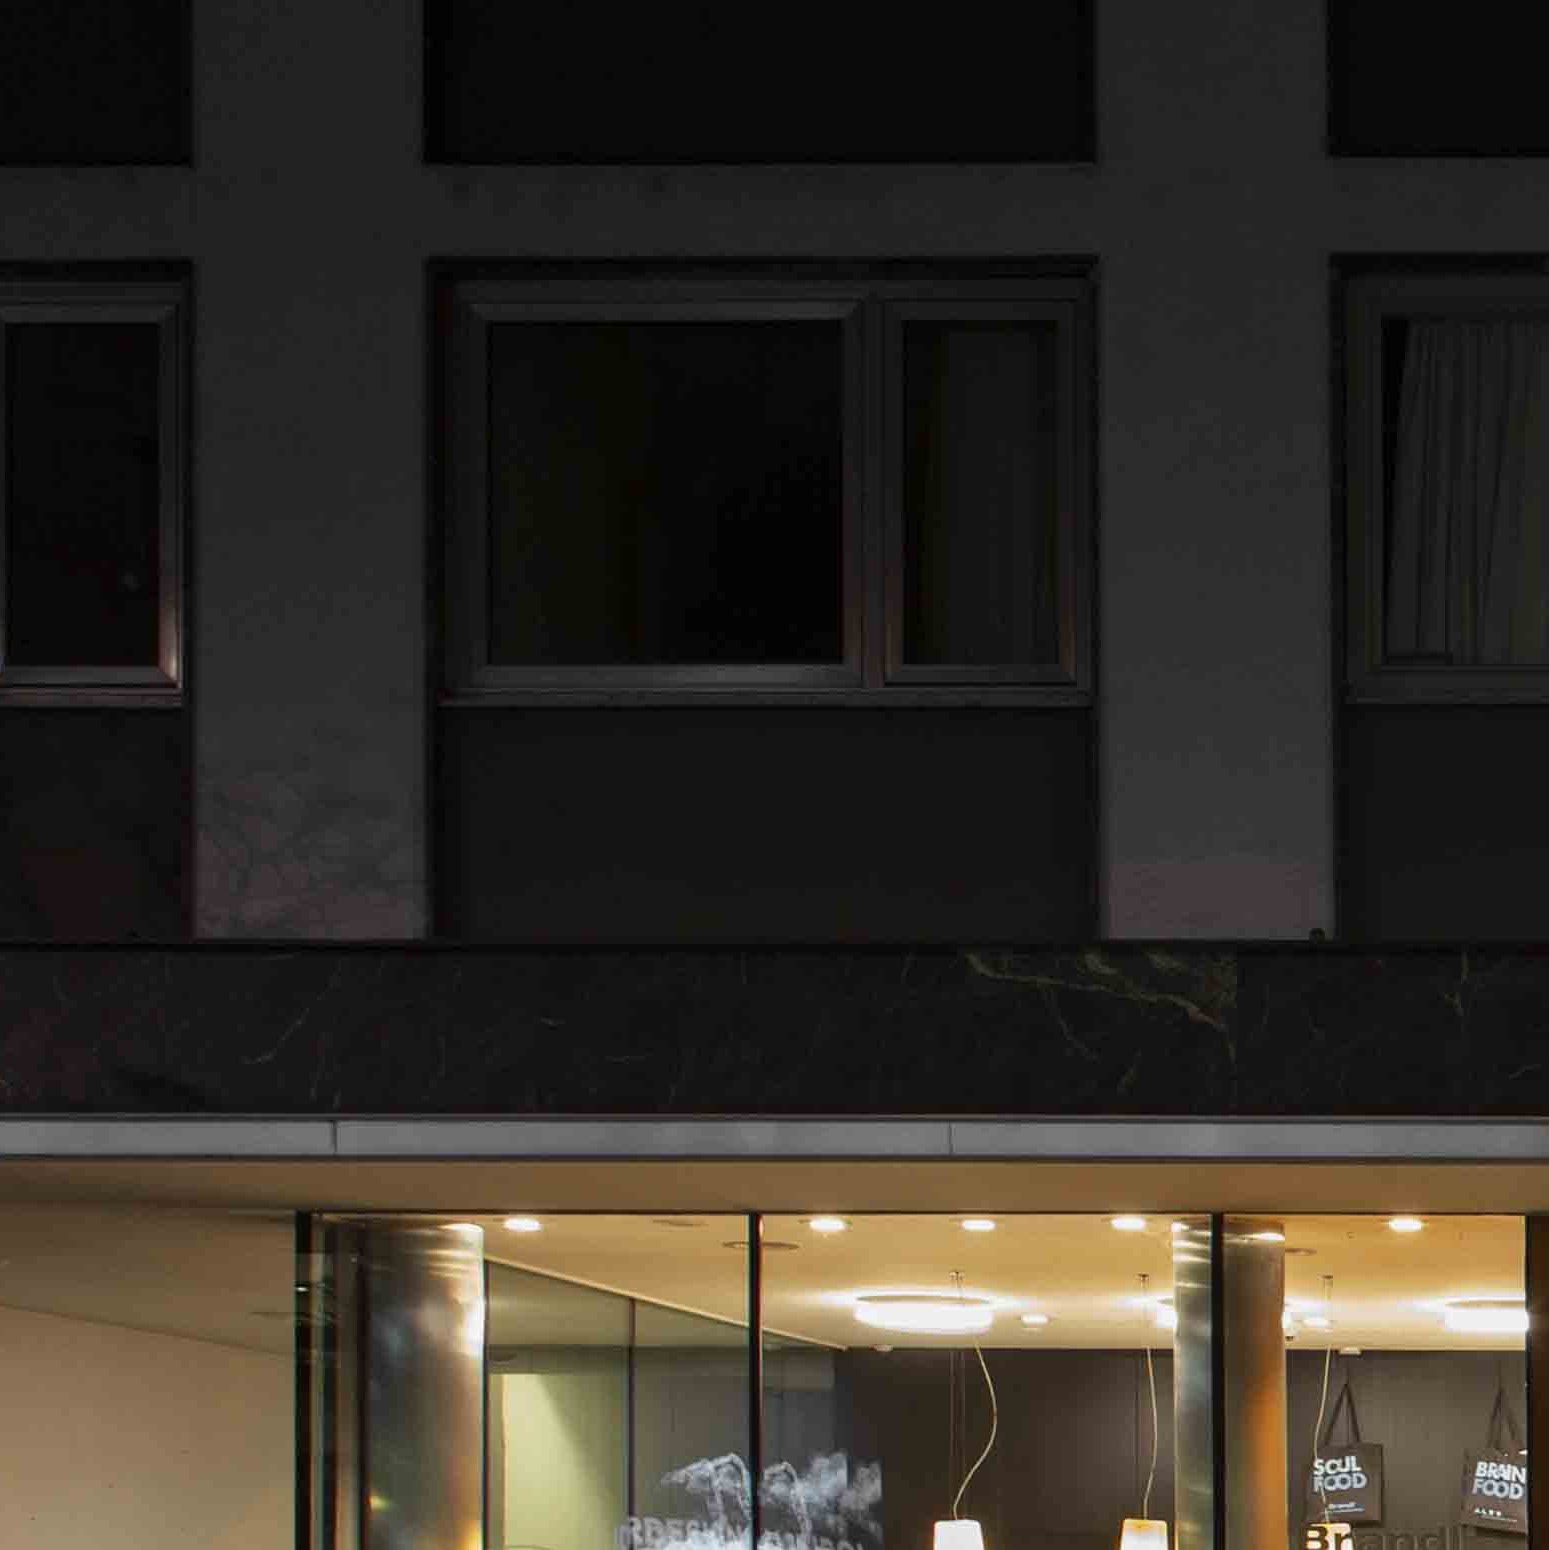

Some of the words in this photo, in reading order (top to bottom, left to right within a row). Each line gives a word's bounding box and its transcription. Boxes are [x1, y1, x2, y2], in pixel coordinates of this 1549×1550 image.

[1313, 1456, 1361, 1475] SOUL
[1475, 1461, 1527, 1484] BRAIN
[1313, 1473, 1368, 1492] FOOD
[1472, 1479, 1525, 1500] FOOD
